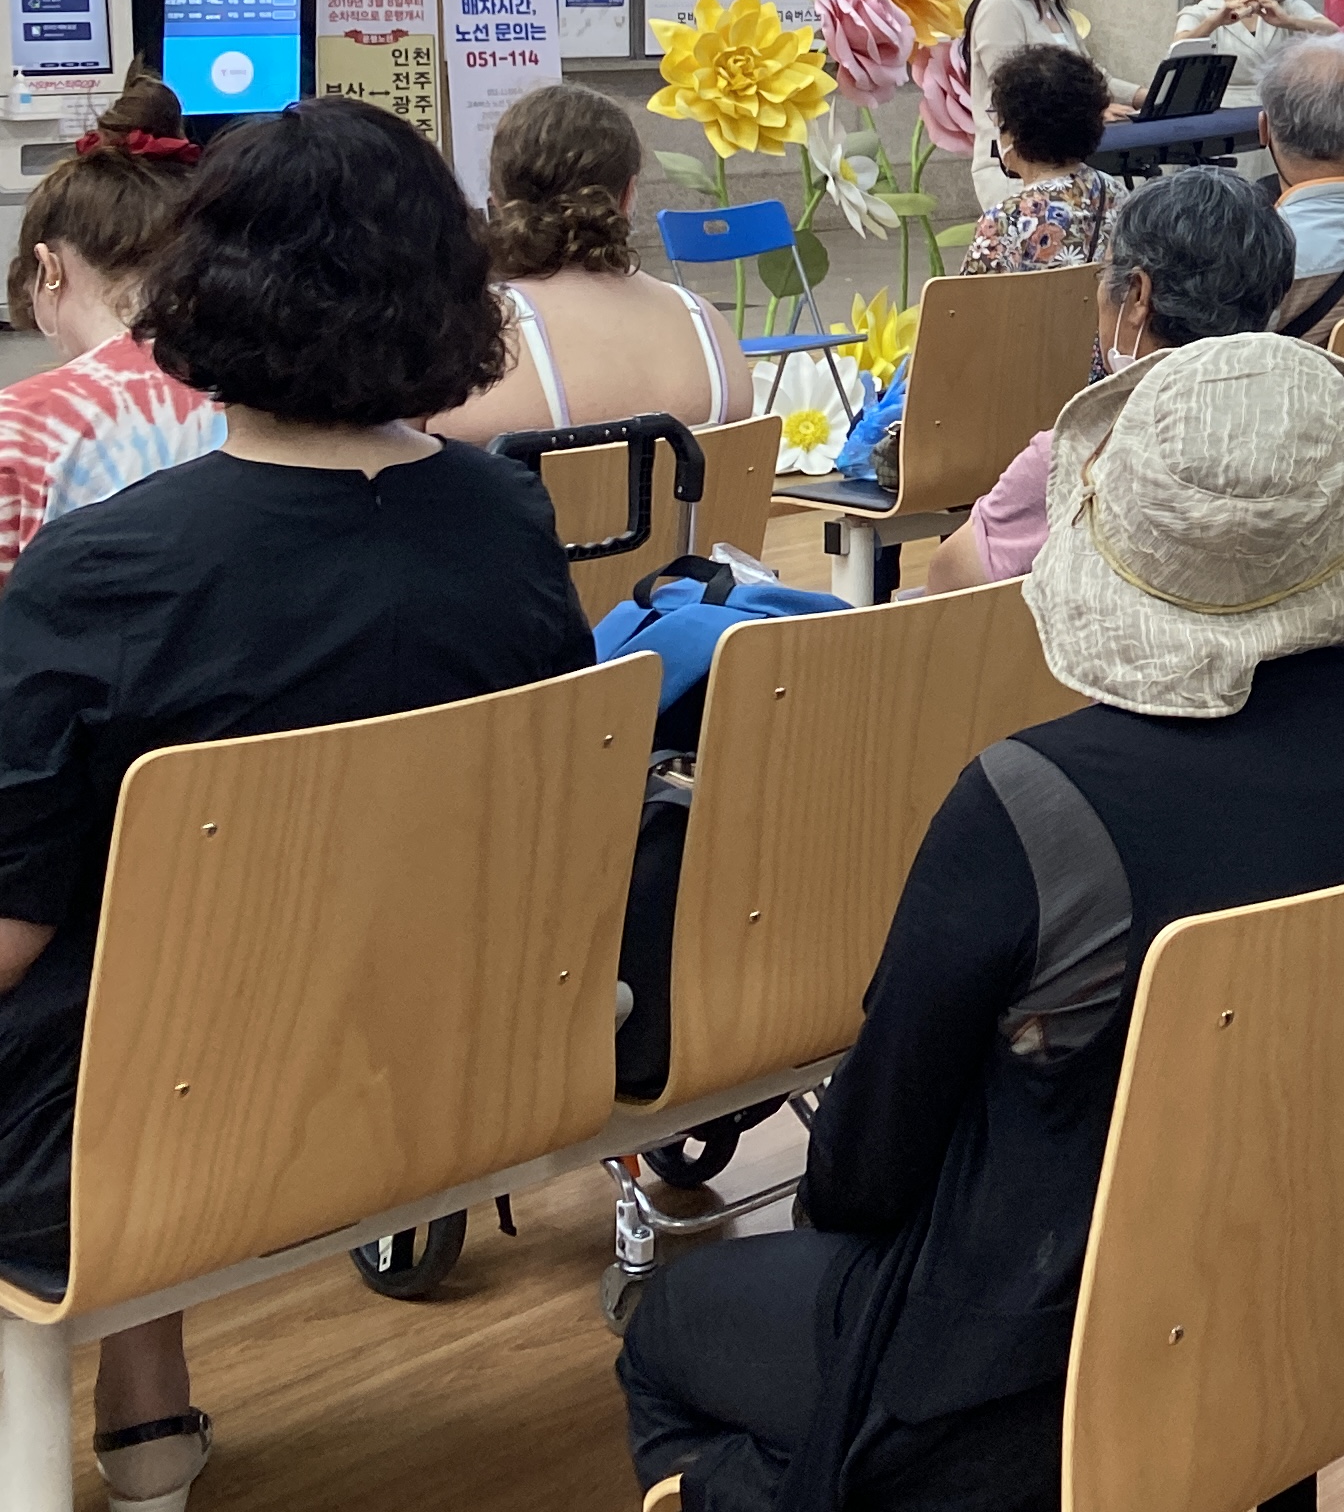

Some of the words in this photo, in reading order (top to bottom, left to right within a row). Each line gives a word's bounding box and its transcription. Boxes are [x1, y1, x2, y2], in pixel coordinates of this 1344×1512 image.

[455, 23, 490, 42] 노선
[495, 22, 547, 42] 문의는
[466, 49, 540, 68] 051-114
